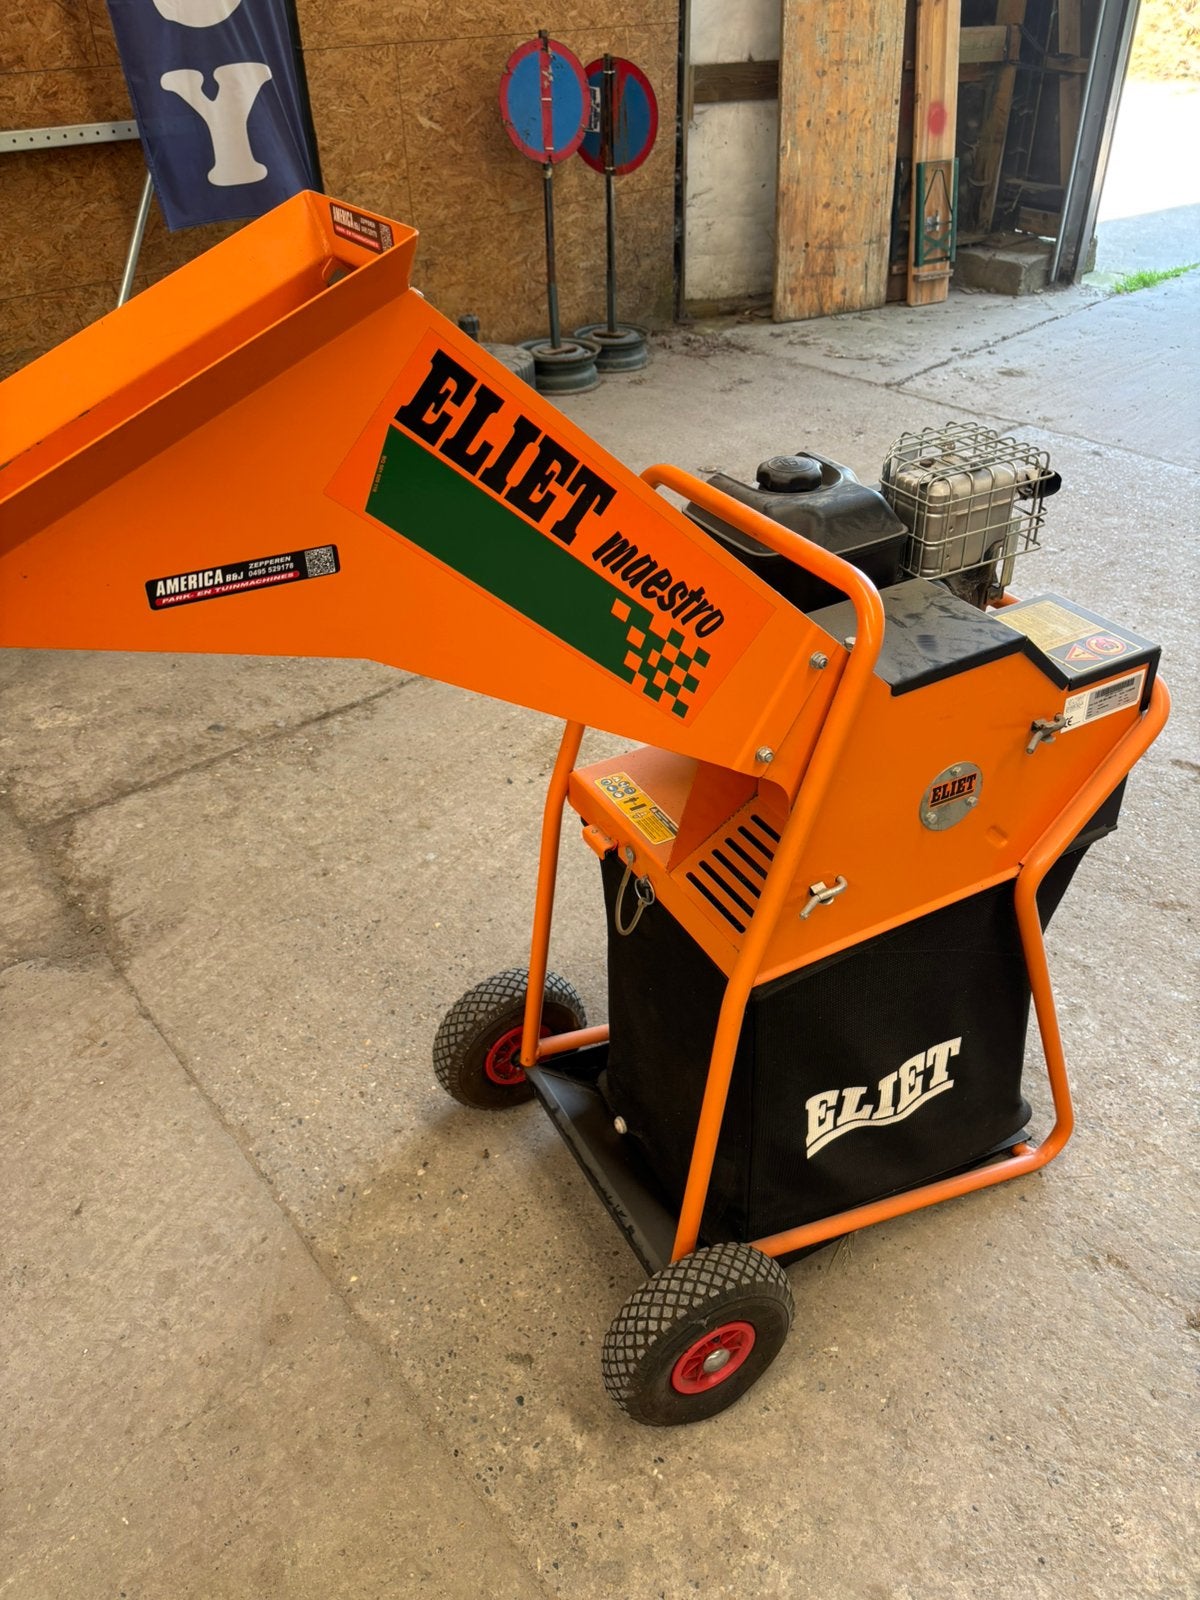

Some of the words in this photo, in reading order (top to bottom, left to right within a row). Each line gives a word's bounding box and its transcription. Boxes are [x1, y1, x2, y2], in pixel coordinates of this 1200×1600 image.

[394, 348, 617, 546] ELIET
[248, 555, 292, 569] ZEPPEREN
[248, 566, 266, 577] 0495
[156, 569, 223, 597] AMERICA
[162, 594, 195, 604] PARK-
[196, 589, 212, 598] EN
[215, 572, 295, 593] TUINMACHINES
[591, 530, 725, 639] maestro
[931, 773, 977, 803] ELIET
[805, 1036, 962, 1148] ELIET
